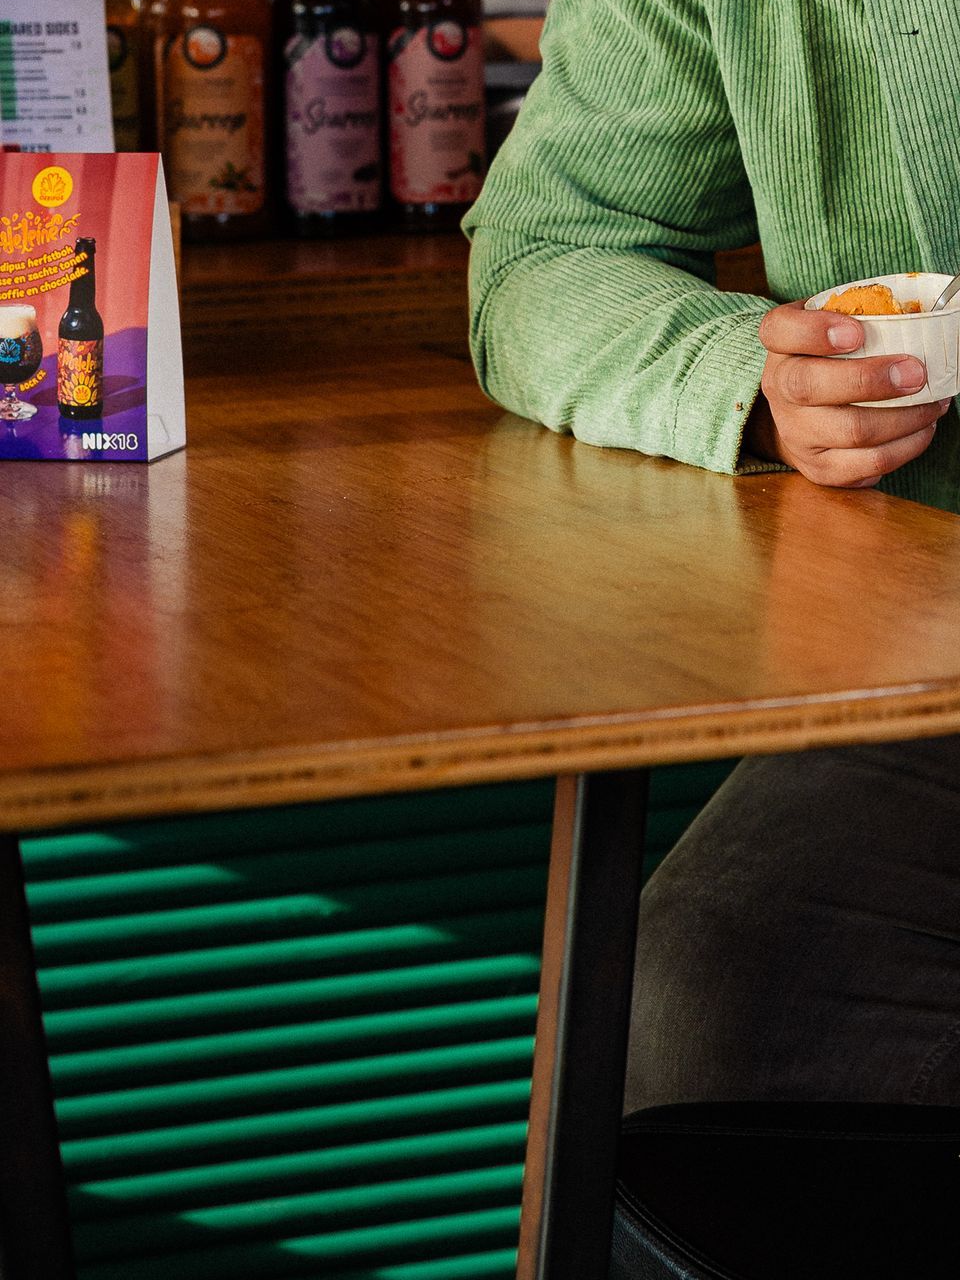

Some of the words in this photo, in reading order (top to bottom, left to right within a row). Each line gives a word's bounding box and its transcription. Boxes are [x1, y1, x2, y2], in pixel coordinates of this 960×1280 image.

[13, 275, 26, 284] en
[27, 266, 59, 281] zachte
[59, 252, 88, 270] tonen
[27, 245, 74, 268] herfstbok
[26, 286, 39, 296] en
[40, 267, 89, 293] chocolade.
[82, 433, 138, 450] NIX18
